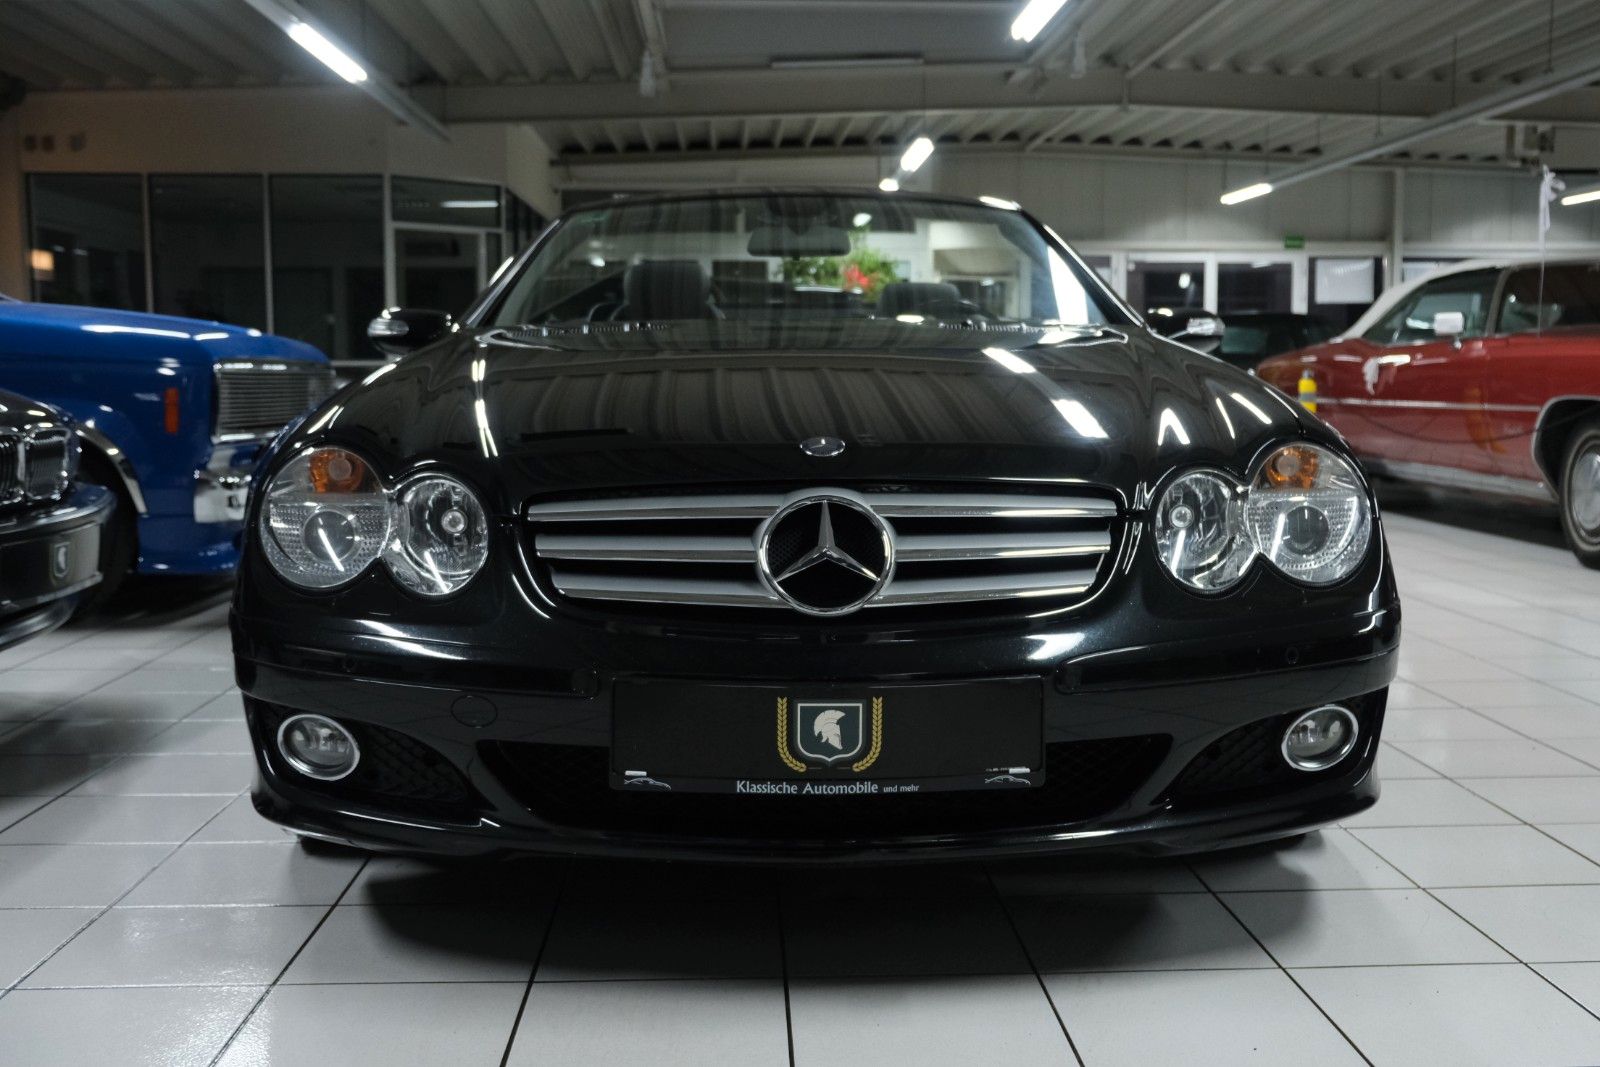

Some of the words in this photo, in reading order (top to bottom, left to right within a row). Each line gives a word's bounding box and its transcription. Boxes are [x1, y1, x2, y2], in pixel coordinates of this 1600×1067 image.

[736, 780, 798, 794] Klassische
[802, 781, 879, 795] Automobile
[883, 783, 898, 793] und
[899, 783, 920, 793] mehr
